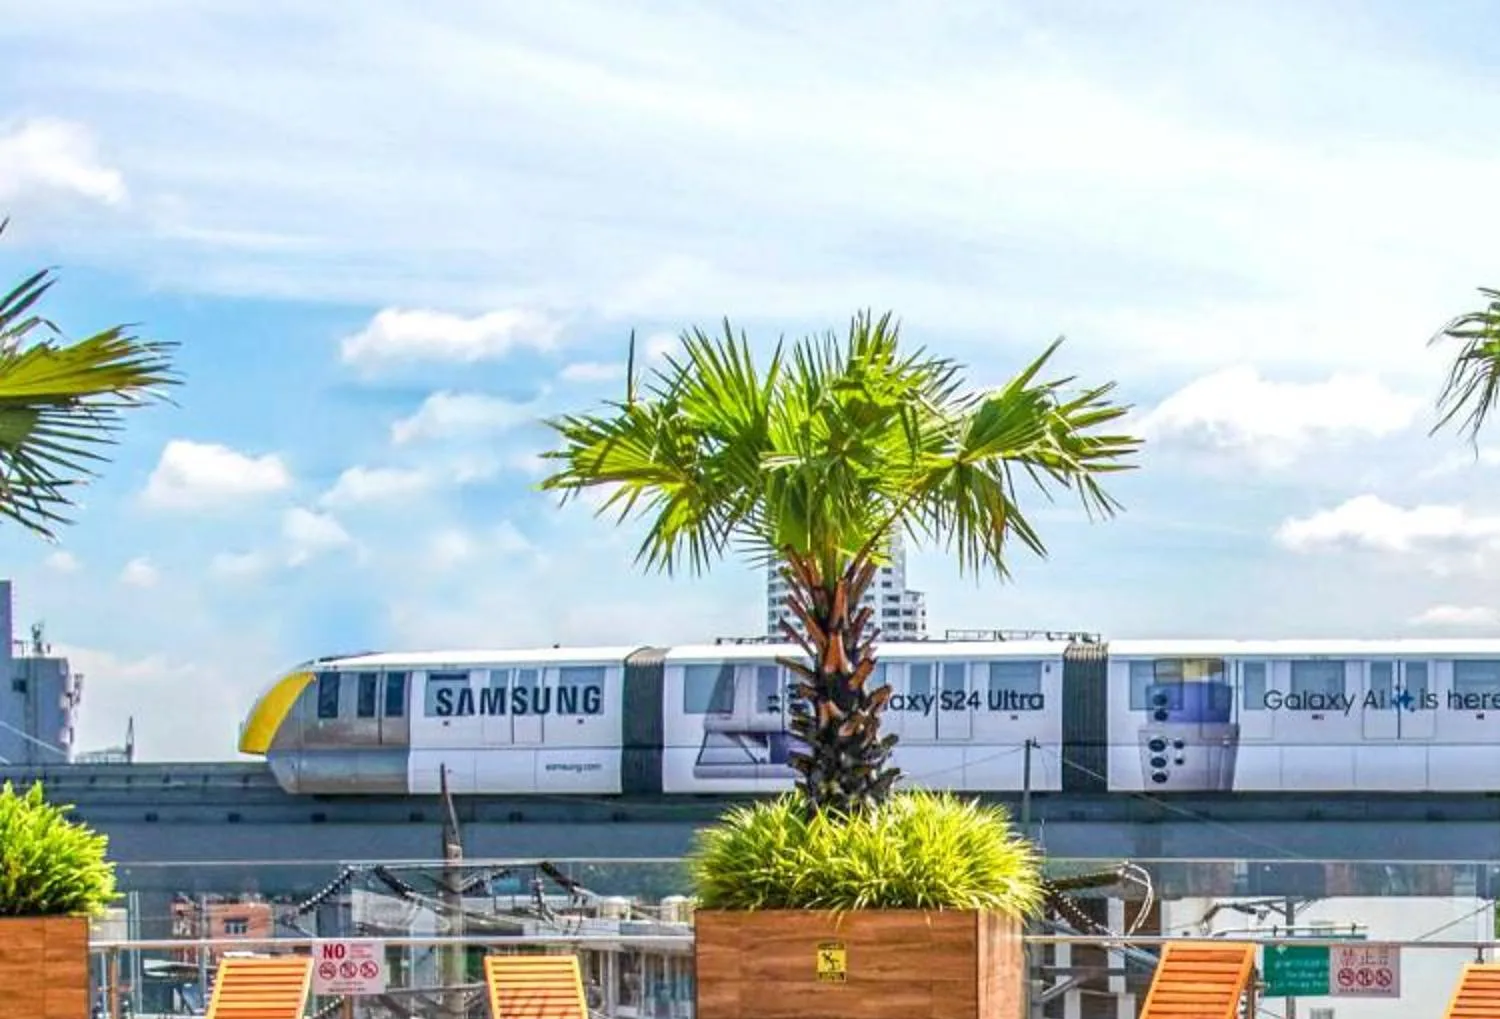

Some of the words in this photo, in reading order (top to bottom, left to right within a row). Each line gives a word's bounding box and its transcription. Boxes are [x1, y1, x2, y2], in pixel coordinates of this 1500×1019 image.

[436, 685, 601, 717] SAMSUNG
[940, 690, 981, 711] S24
[988, 689, 1044, 711] Ultra
[1263, 689, 1355, 716] Galaxy
[1419, 688, 1438, 710] is
[323, 943, 345, 959] NO
